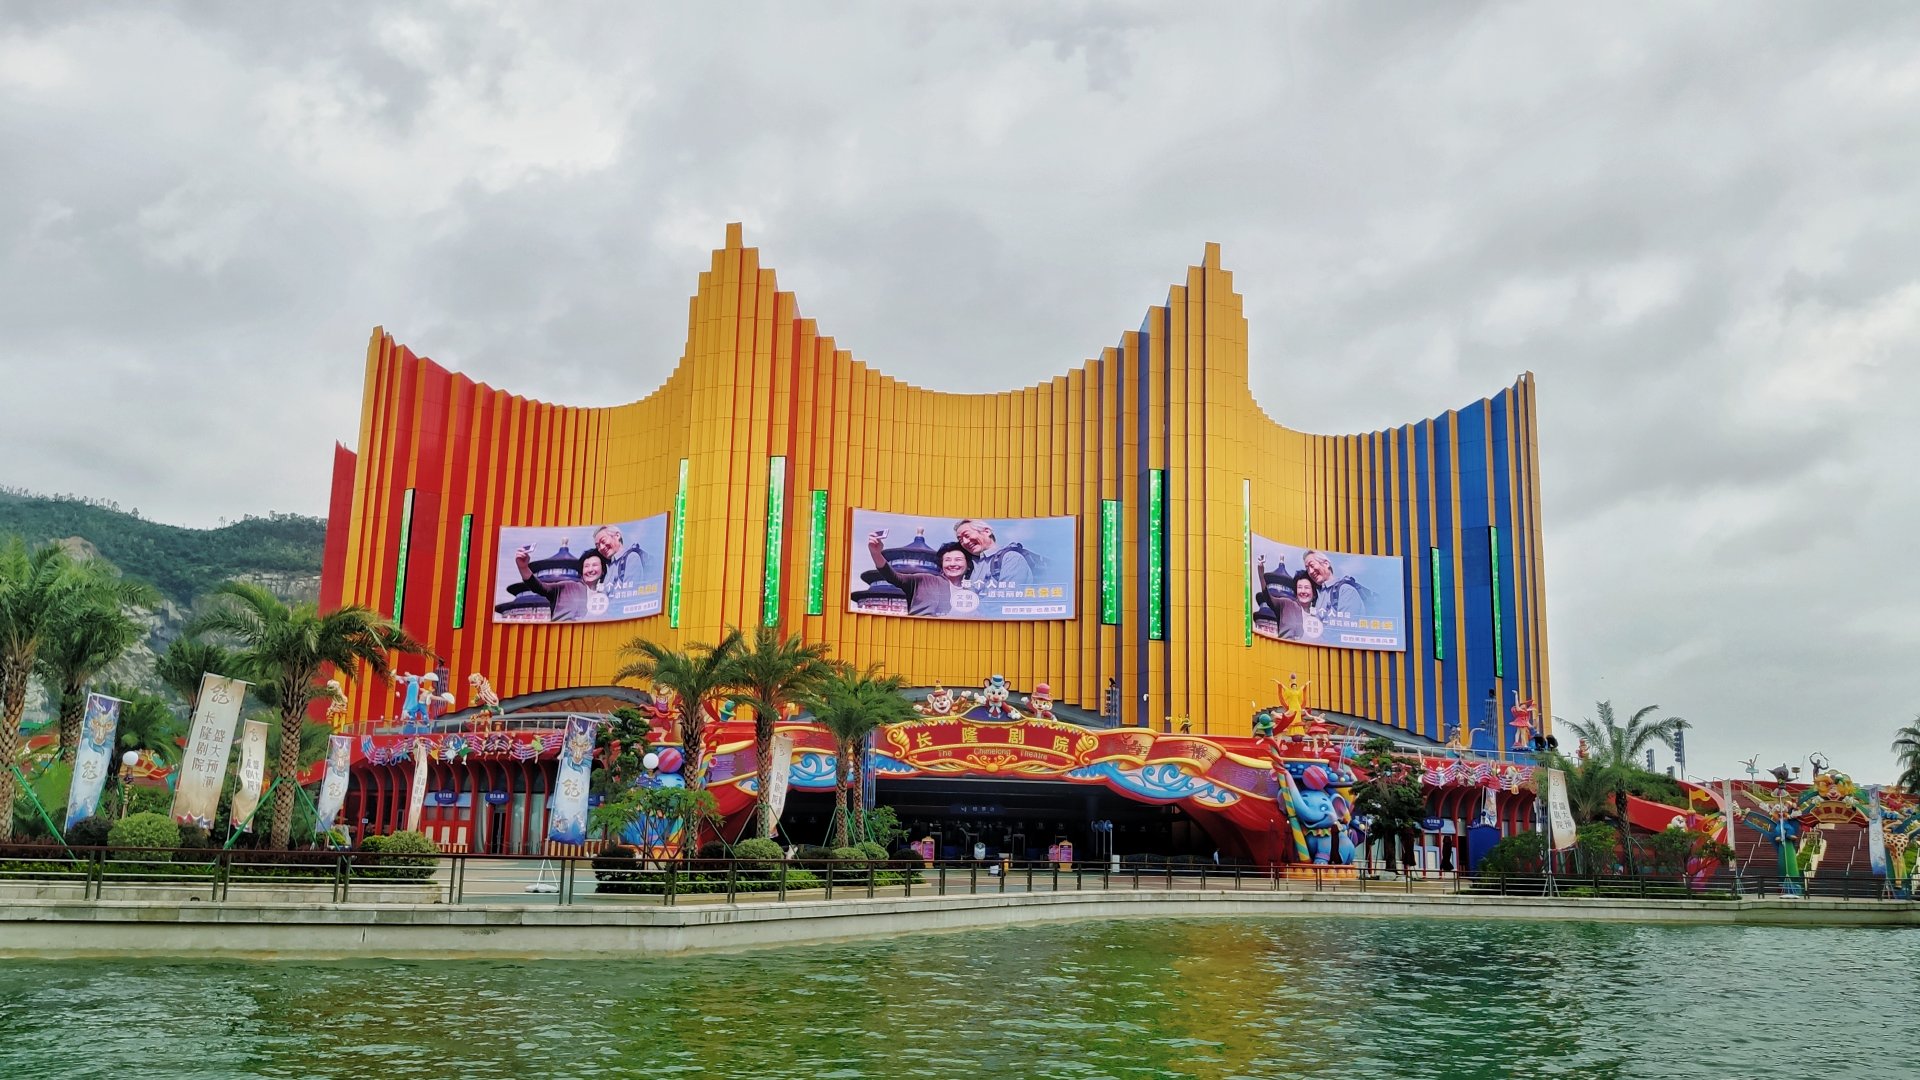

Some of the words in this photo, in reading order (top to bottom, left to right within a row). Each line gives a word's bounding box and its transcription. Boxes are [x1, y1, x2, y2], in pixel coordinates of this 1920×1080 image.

[961, 580, 1016, 589] 每个人都是
[191, 711, 216, 772] 长隆剧院
[916, 727, 1070, 753] 长隆剧院
[202, 729, 226, 789] 盛大预演
[938, 749, 953, 758] The
[973, 747, 1012, 757] Chimelong
[1020, 749, 1048, 761] Theatre
